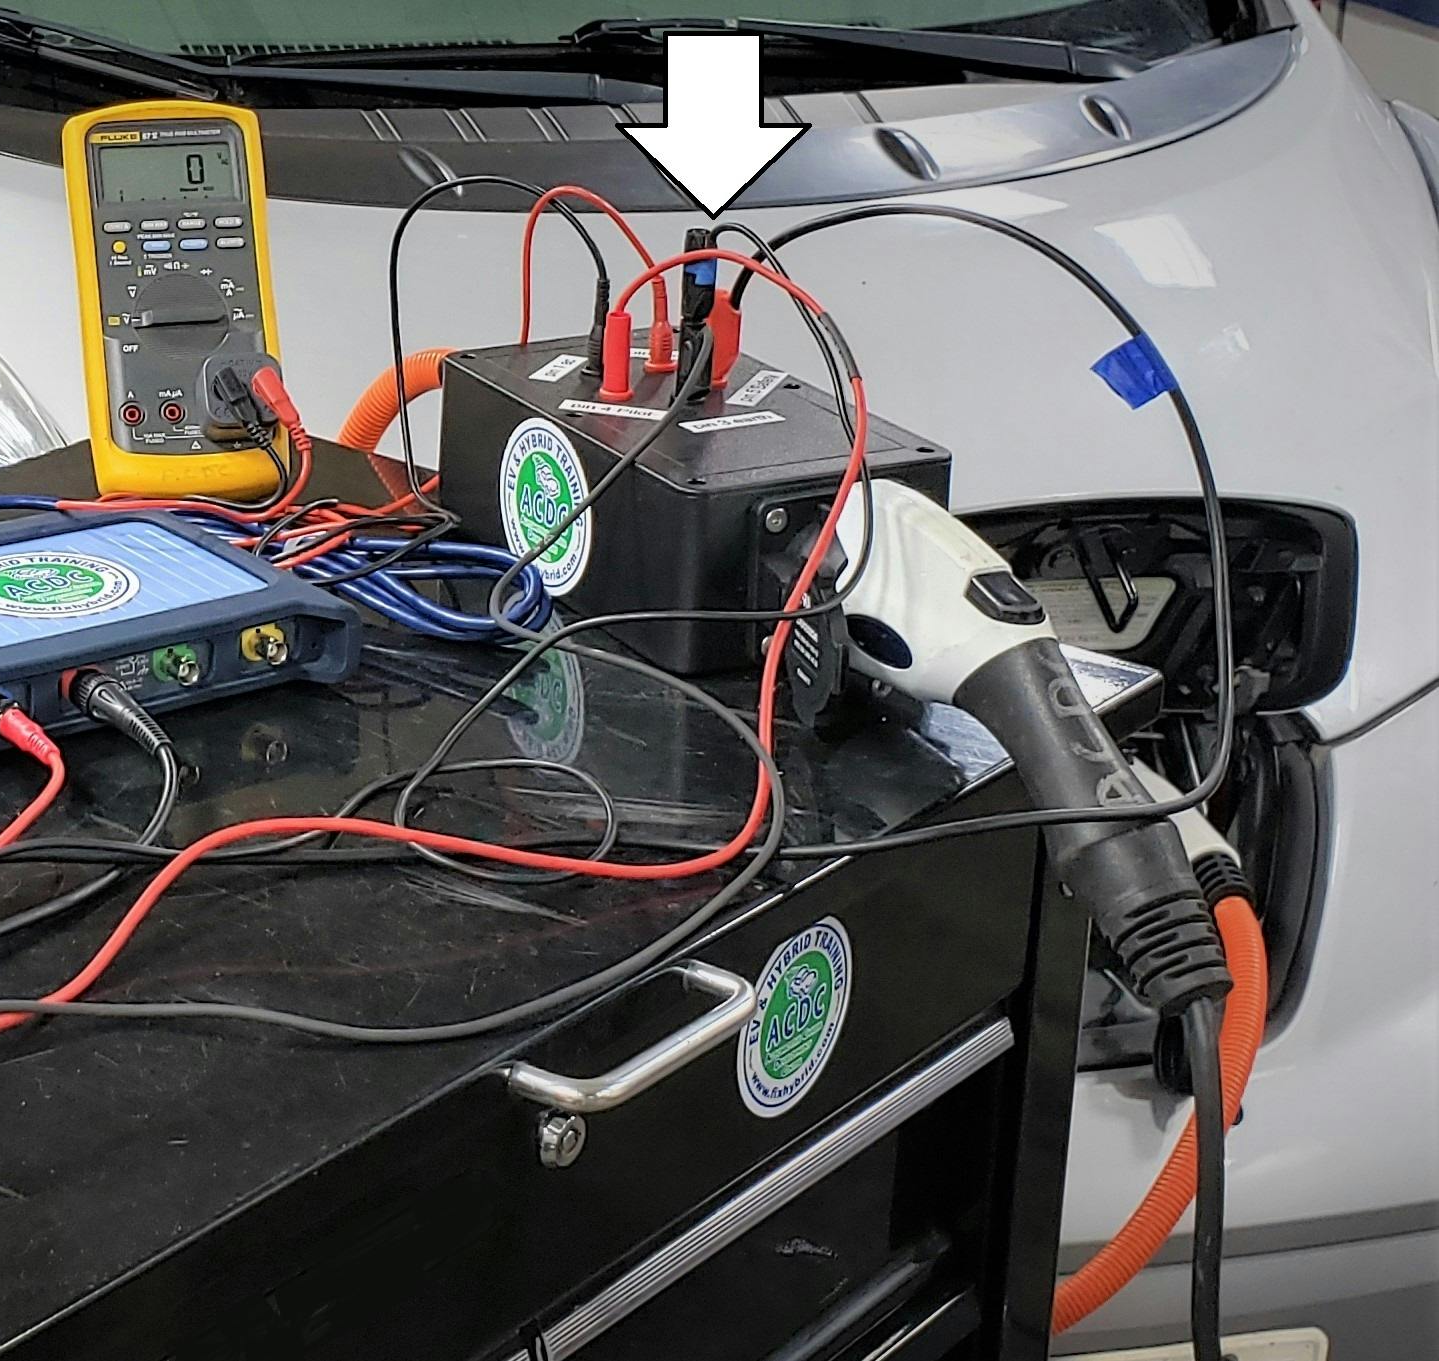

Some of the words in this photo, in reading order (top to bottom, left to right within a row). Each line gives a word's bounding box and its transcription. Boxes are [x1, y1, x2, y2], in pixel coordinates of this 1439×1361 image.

[100, 133, 138, 141] FLUKE
[186, 154, 205, 184] 0
[143, 265, 157, 276] mV
[122, 344, 139, 352] OFF
[127, 390, 135, 398] A
[570, 402, 599, 412] pin
[617, 407, 653, 417] Pilot
[507, 468, 517, 491] EV
[520, 432, 554, 453] HYBRID
[556, 444, 584, 527] TRAINIG
[520, 484, 570, 534] ACDC
[26, 556, 111, 573] TRAINING
[510, 520, 577, 581] wwwybrid.com
[5, 579, 123, 612] www.fixhybrid.com
[6, 569, 94, 598] ACDC
[749, 1019, 761, 1045] EV
[759, 997, 768, 1011] &
[767, 934, 811, 990] HYBRID
[815, 930, 845, 991] TRAINING
[766, 984, 827, 1049] ACDC
[751, 1021, 835, 1099] www.fixhybrid.com
